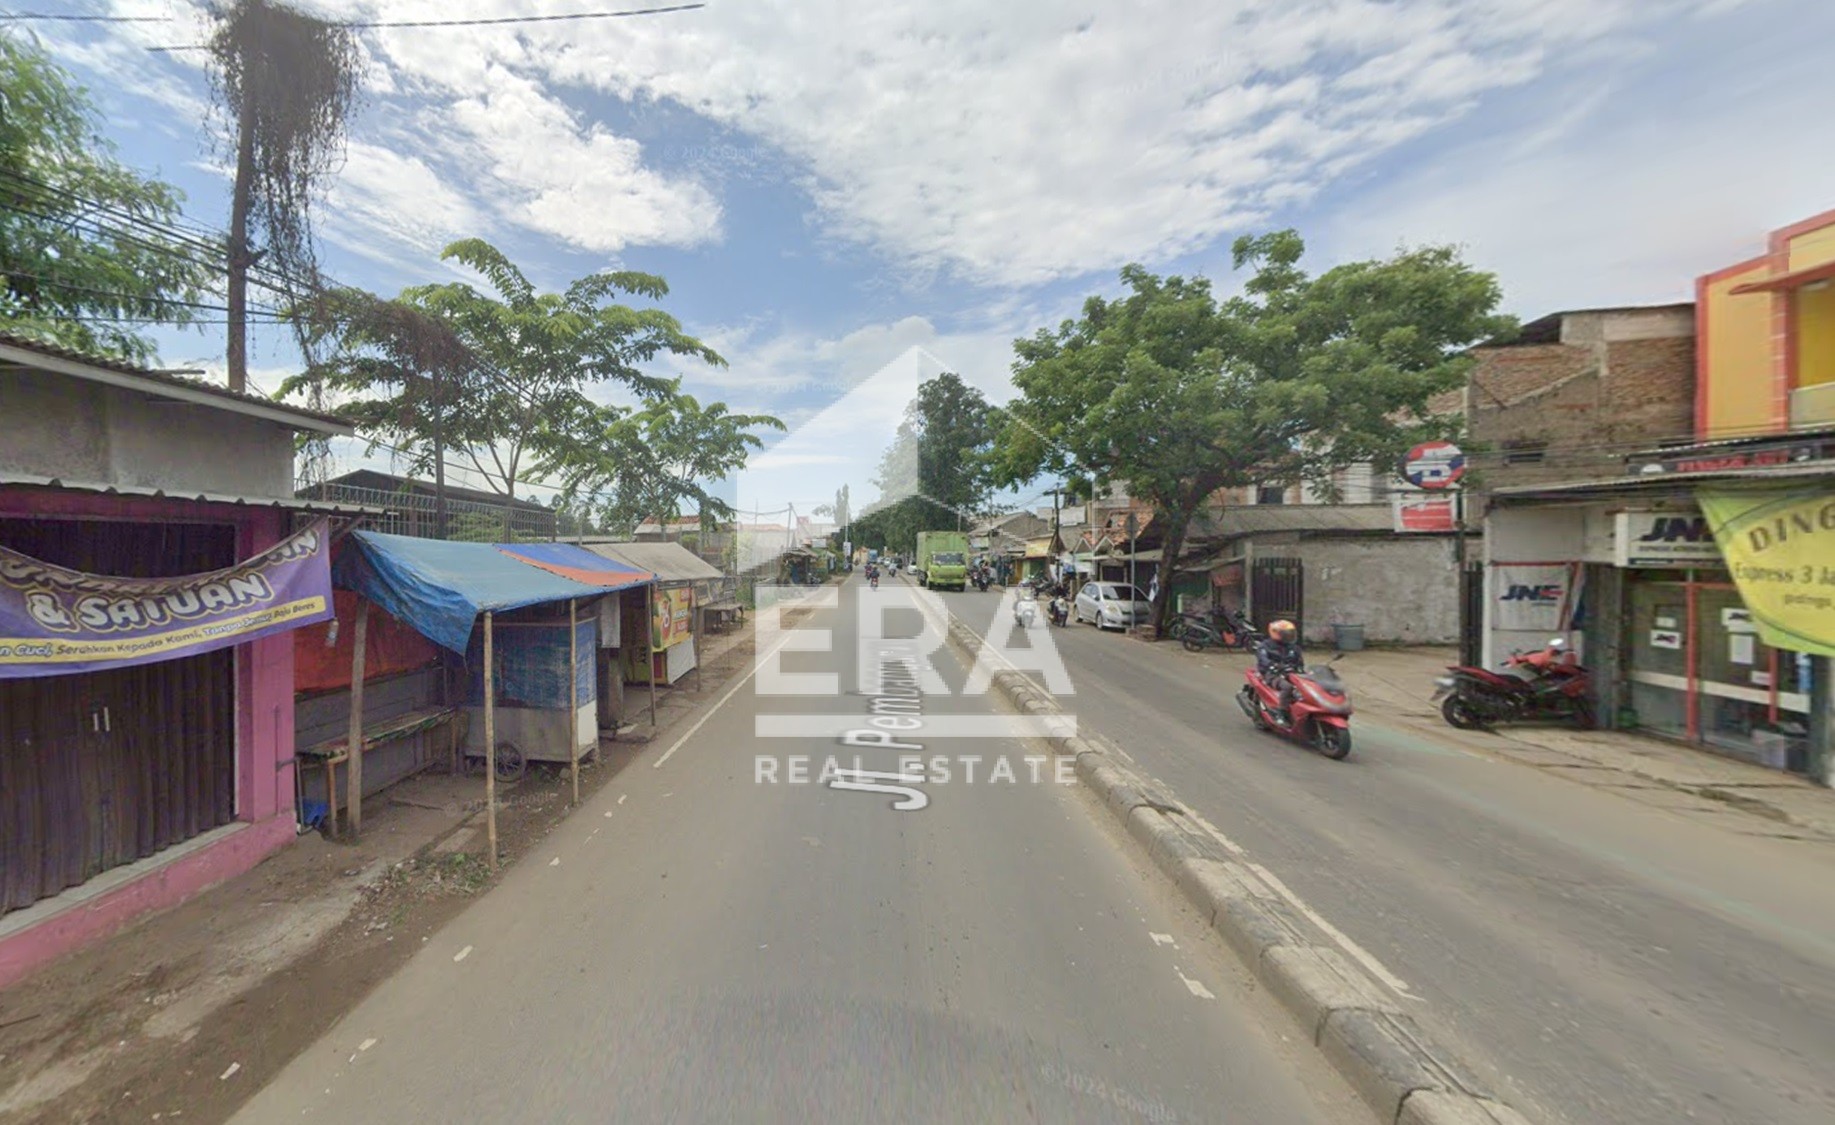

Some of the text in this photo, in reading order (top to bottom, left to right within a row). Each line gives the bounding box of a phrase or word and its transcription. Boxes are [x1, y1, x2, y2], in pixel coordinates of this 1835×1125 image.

[1801, 565, 1813, 584] 3
[1499, 585, 1567, 601] JNE
[28, 591, 78, 631] &
[57, 645, 114, 655] Serahkan
[117, 640, 163, 653] Kepada
